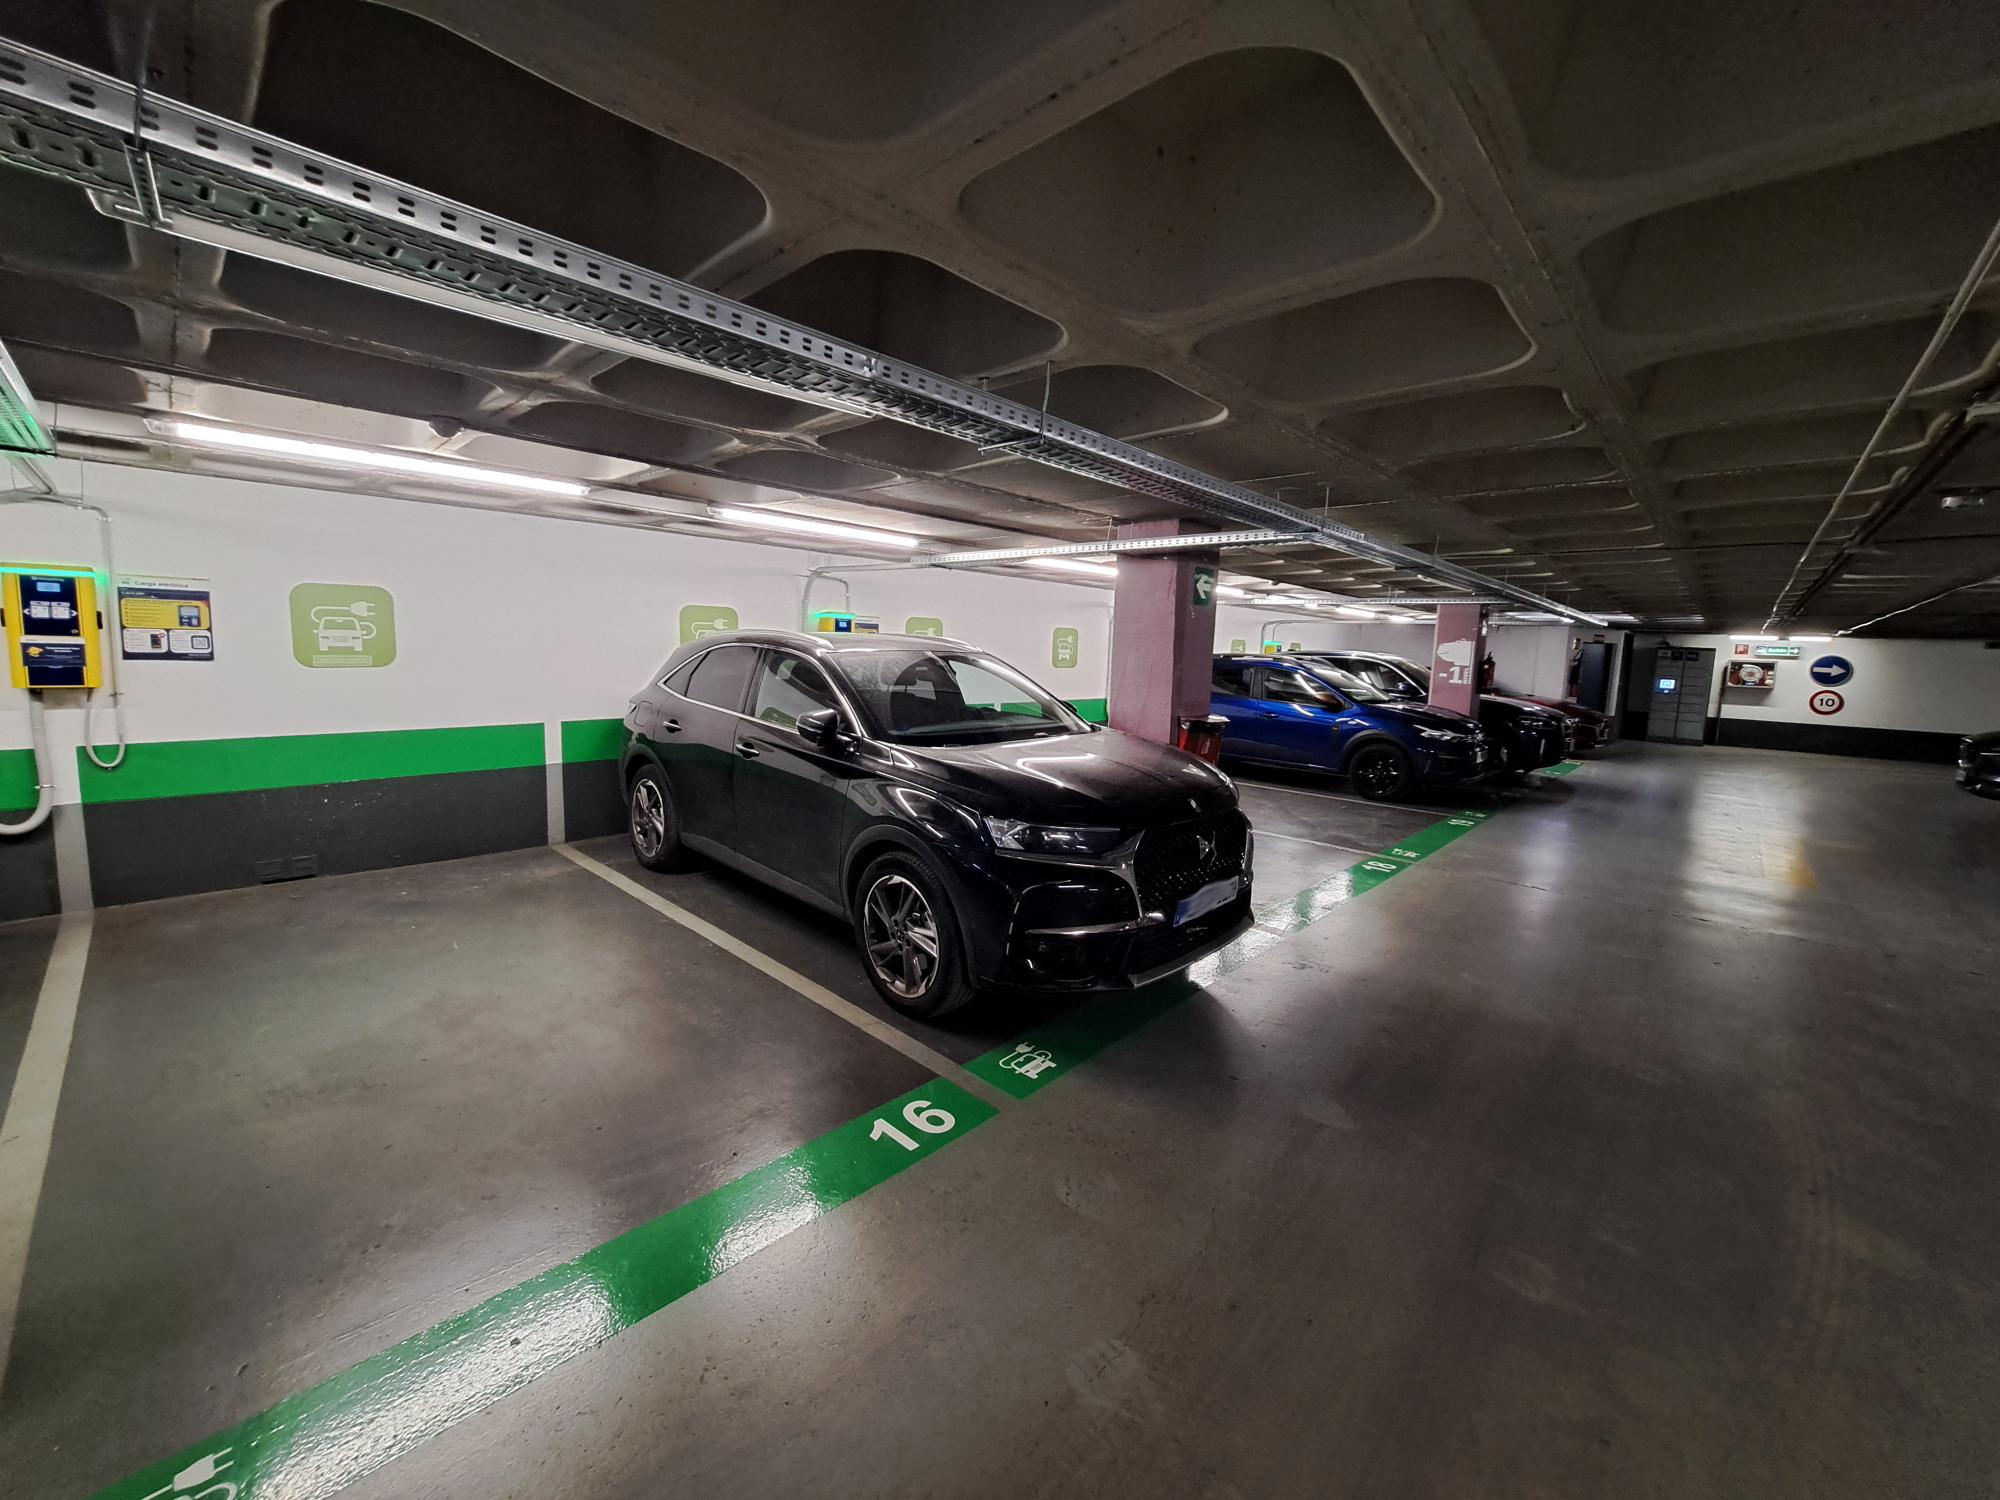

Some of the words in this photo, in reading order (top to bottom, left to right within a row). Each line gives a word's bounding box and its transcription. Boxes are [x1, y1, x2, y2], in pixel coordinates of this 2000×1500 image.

[1818, 697, 1835, 708] 10
[1361, 861, 1398, 872] 18
[869, 1100, 956, 1152] 16
